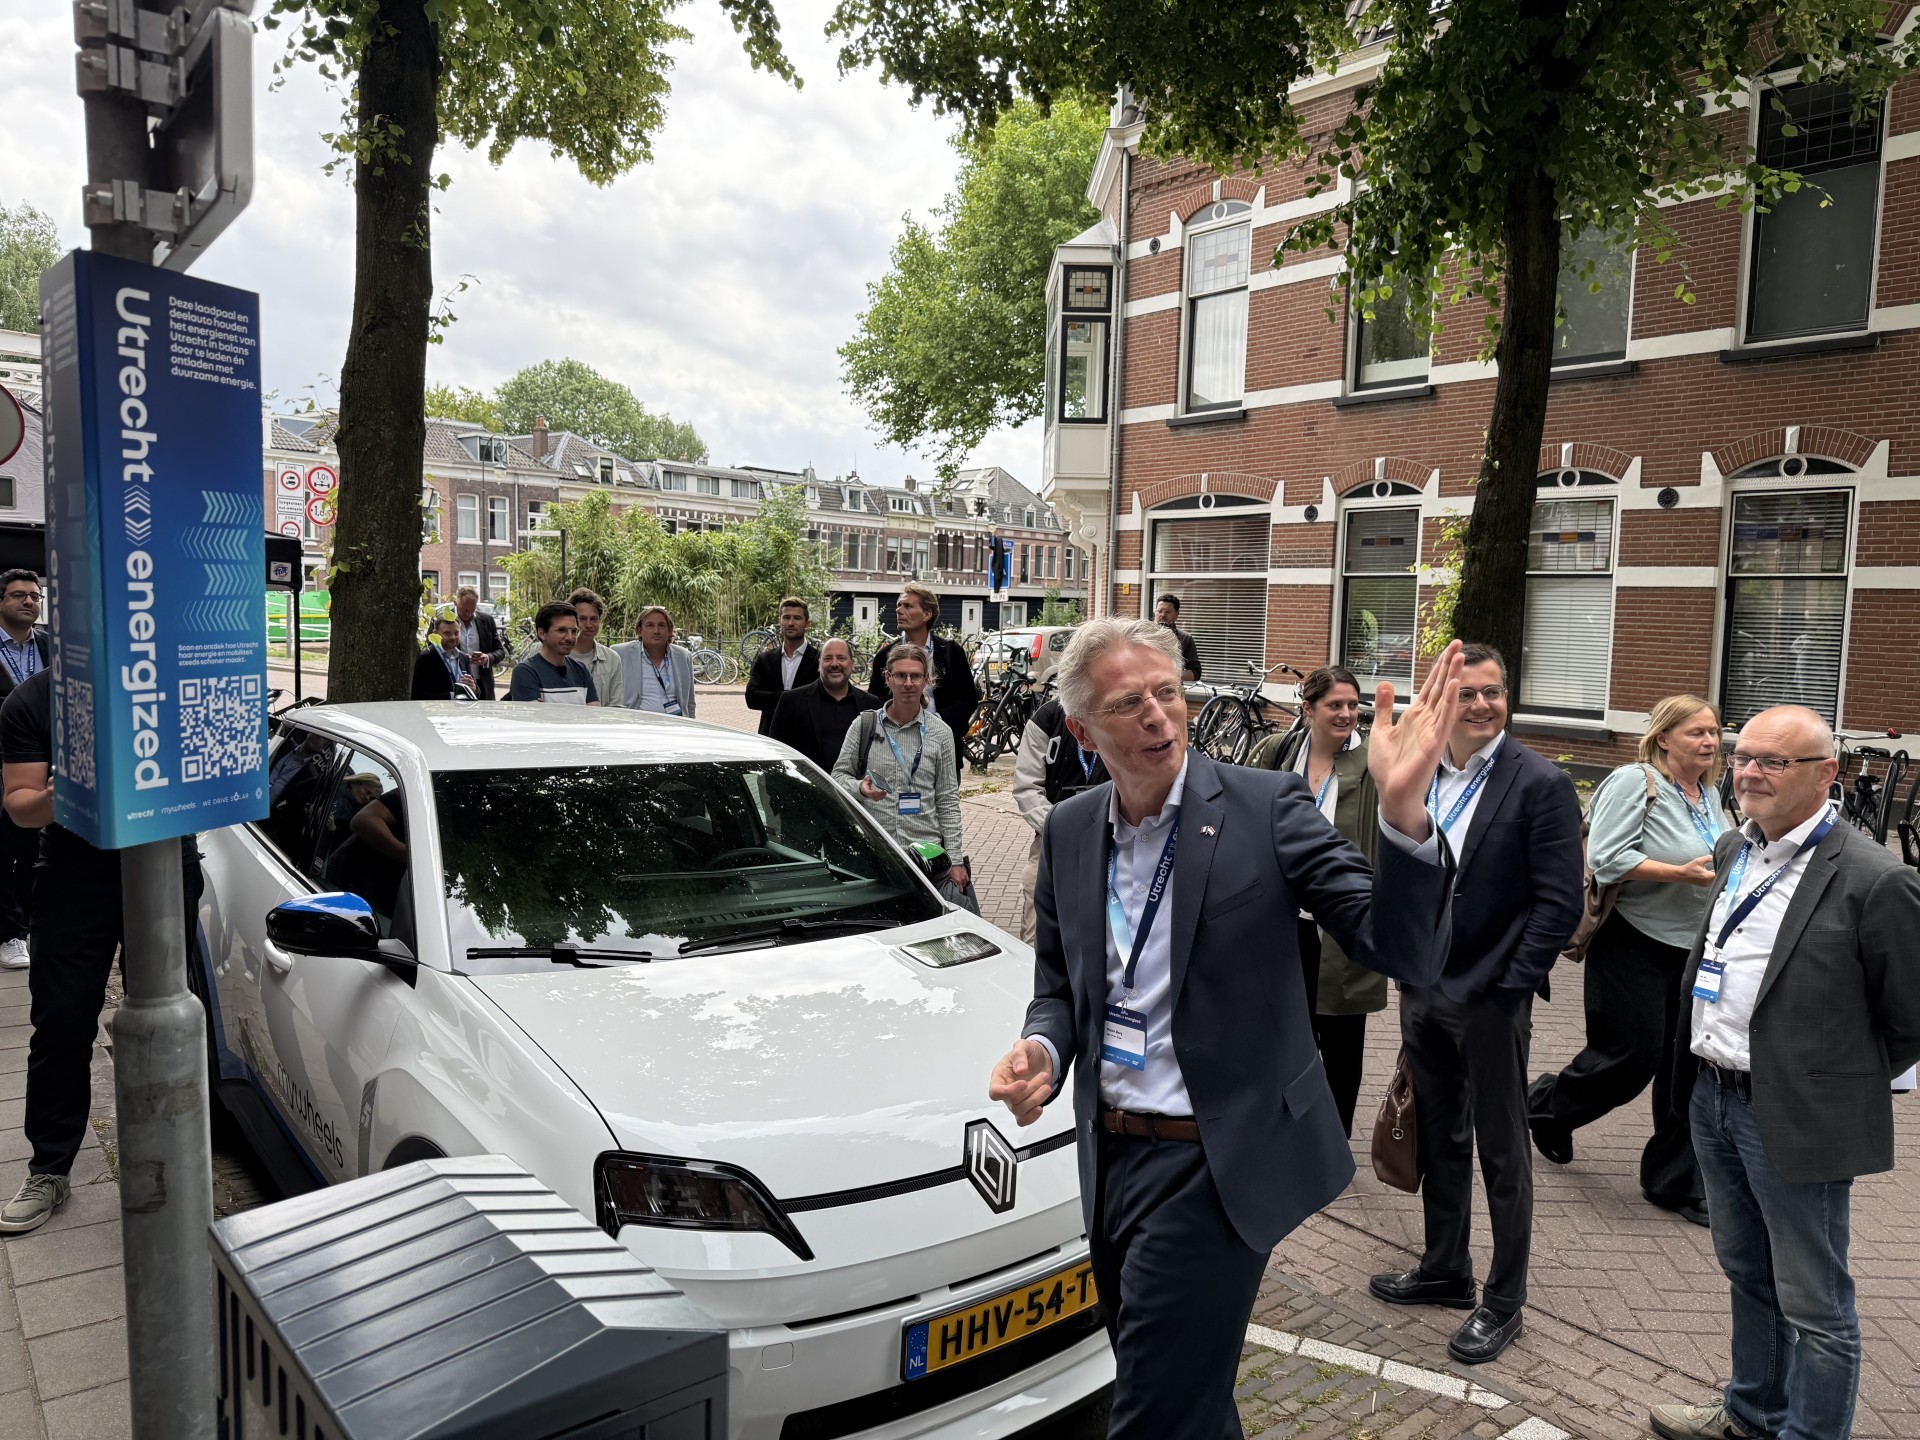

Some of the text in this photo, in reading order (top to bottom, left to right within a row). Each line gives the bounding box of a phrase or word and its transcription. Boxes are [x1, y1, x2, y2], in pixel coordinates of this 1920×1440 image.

[169, 296, 249, 323] Deze laadpaal en
[169, 308, 248, 334] deelauto houden
[169, 319, 256, 346] het energienet van
[170, 331, 249, 355] Utrecht in balans
[170, 343, 245, 366] door te laden én
[170, 356, 234, 374] ontladen met
[115, 287, 158, 483] Utrecht
[171, 366, 257, 389] duurzame energie.
[203, 642, 225, 650] ontdek
[121, 550, 169, 791] energized
[1470, 757, 1495, 790] energized
[161, 801, 197, 815] mywheels
[202, 799, 212, 807] WE
[213, 797, 229, 805] DRIVE
[1446, 795, 1468, 822] Utrecht
[1149, 855, 1172, 902] Utrecht
[277, 1062, 344, 1169] mywheels
[909, 1355, 924, 1370] NL
